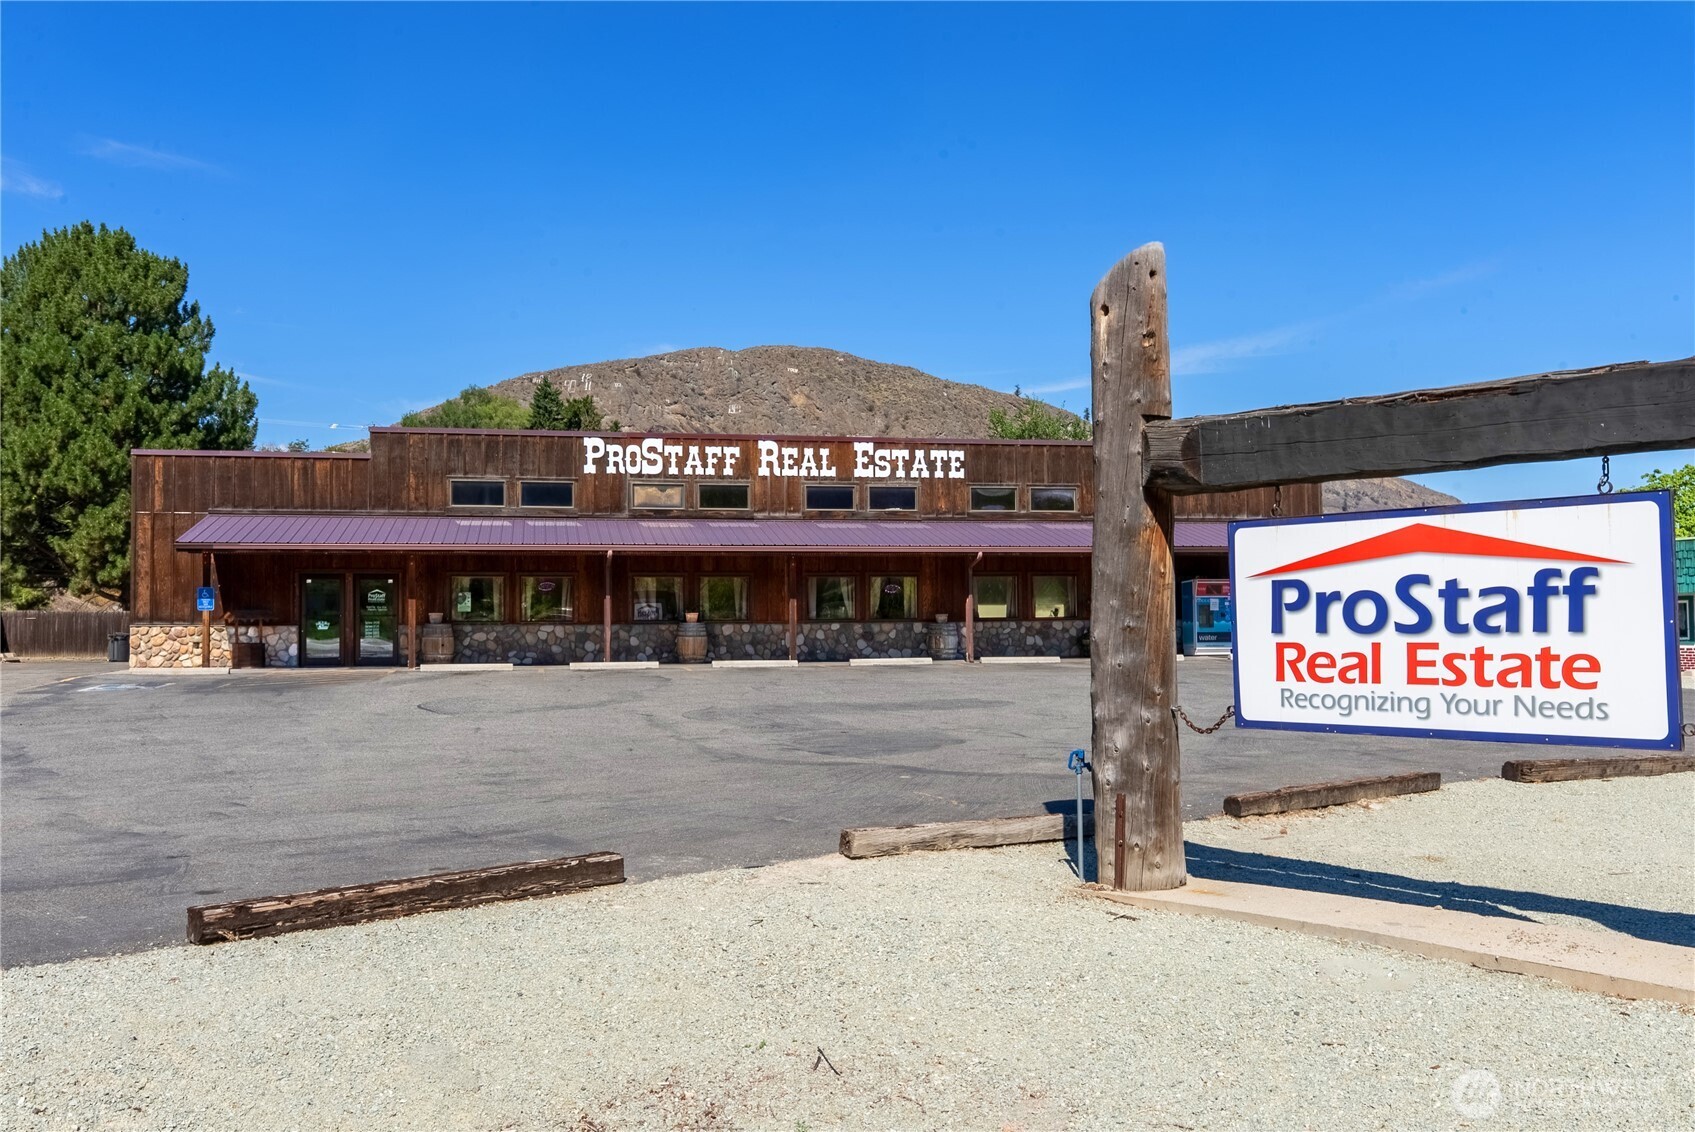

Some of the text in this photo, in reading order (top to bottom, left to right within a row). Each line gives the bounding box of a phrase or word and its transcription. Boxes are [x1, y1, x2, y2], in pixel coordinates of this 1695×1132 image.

[583, 437, 965, 479] PROSTAFF REAL ESTATE
[1271, 567, 1600, 635] ProStaff
[1275, 642, 1602, 690] Real Estate
[1280, 688, 1609, 720] Recognizing Your Needs
